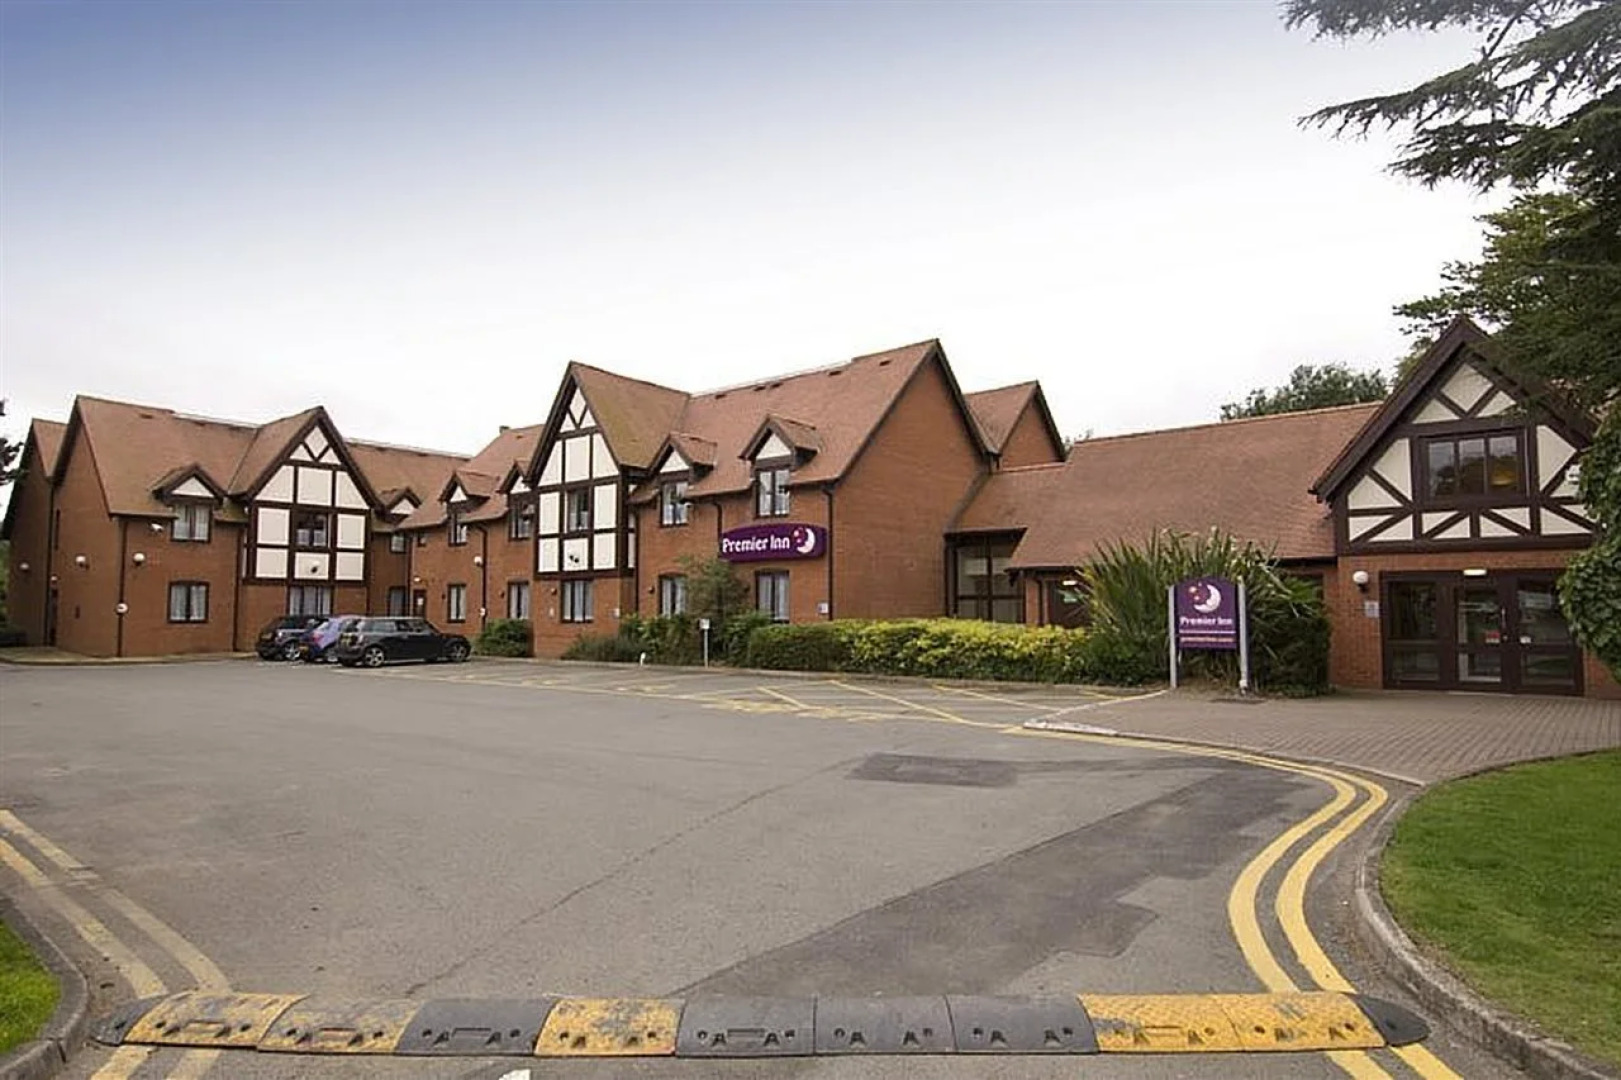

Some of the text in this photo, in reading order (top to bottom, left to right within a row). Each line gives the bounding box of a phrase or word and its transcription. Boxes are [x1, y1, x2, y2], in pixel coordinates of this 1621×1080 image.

[722, 534, 790, 553] Premier Inn
[1179, 616, 1216, 625] Premier
